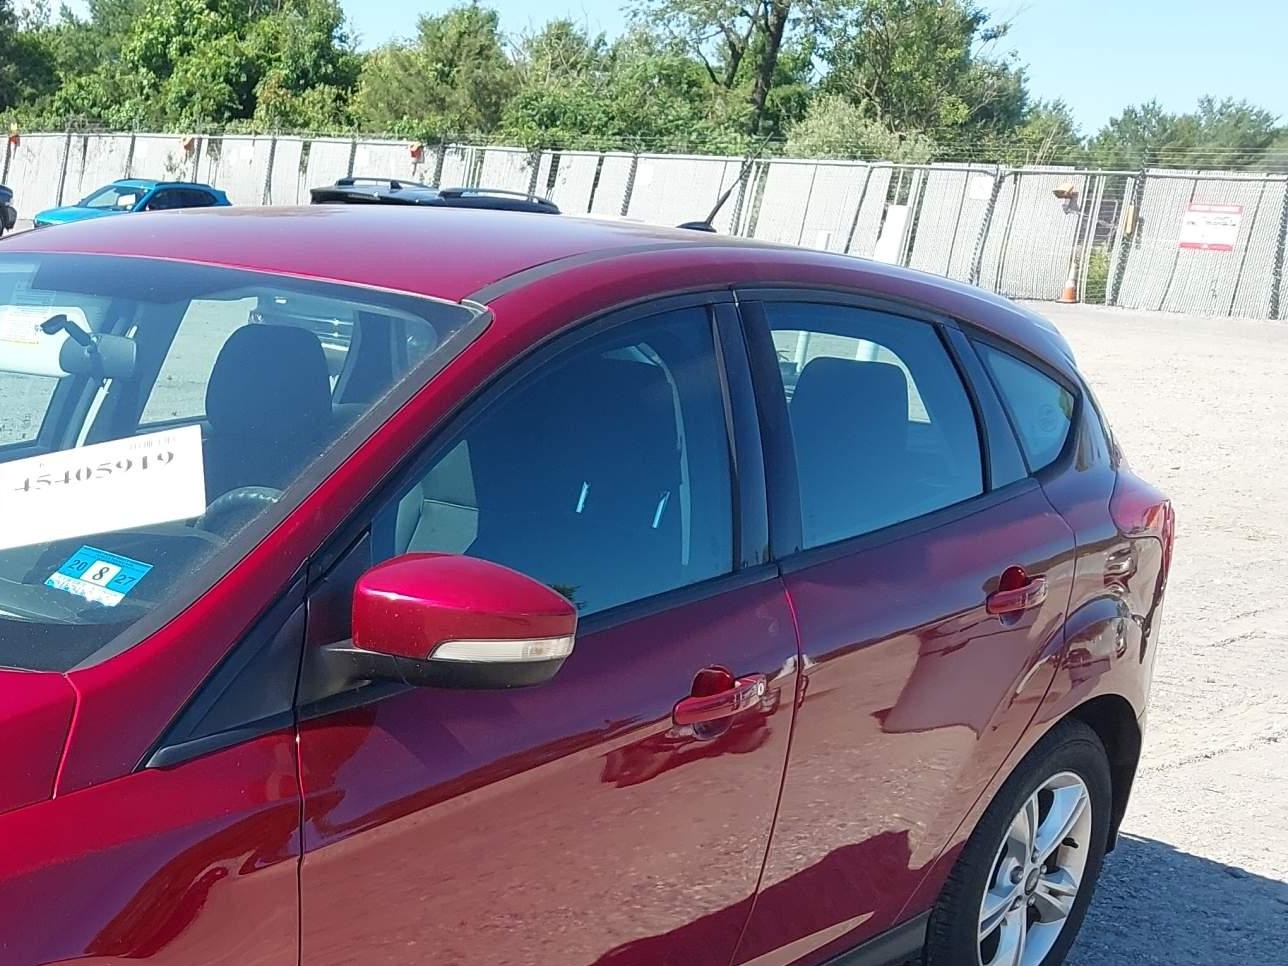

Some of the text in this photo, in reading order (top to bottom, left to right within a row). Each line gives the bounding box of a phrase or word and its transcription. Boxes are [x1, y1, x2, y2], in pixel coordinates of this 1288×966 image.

[68, 559, 89, 571] 20
[92, 566, 110, 581] 8
[115, 574, 137, 586] 27
